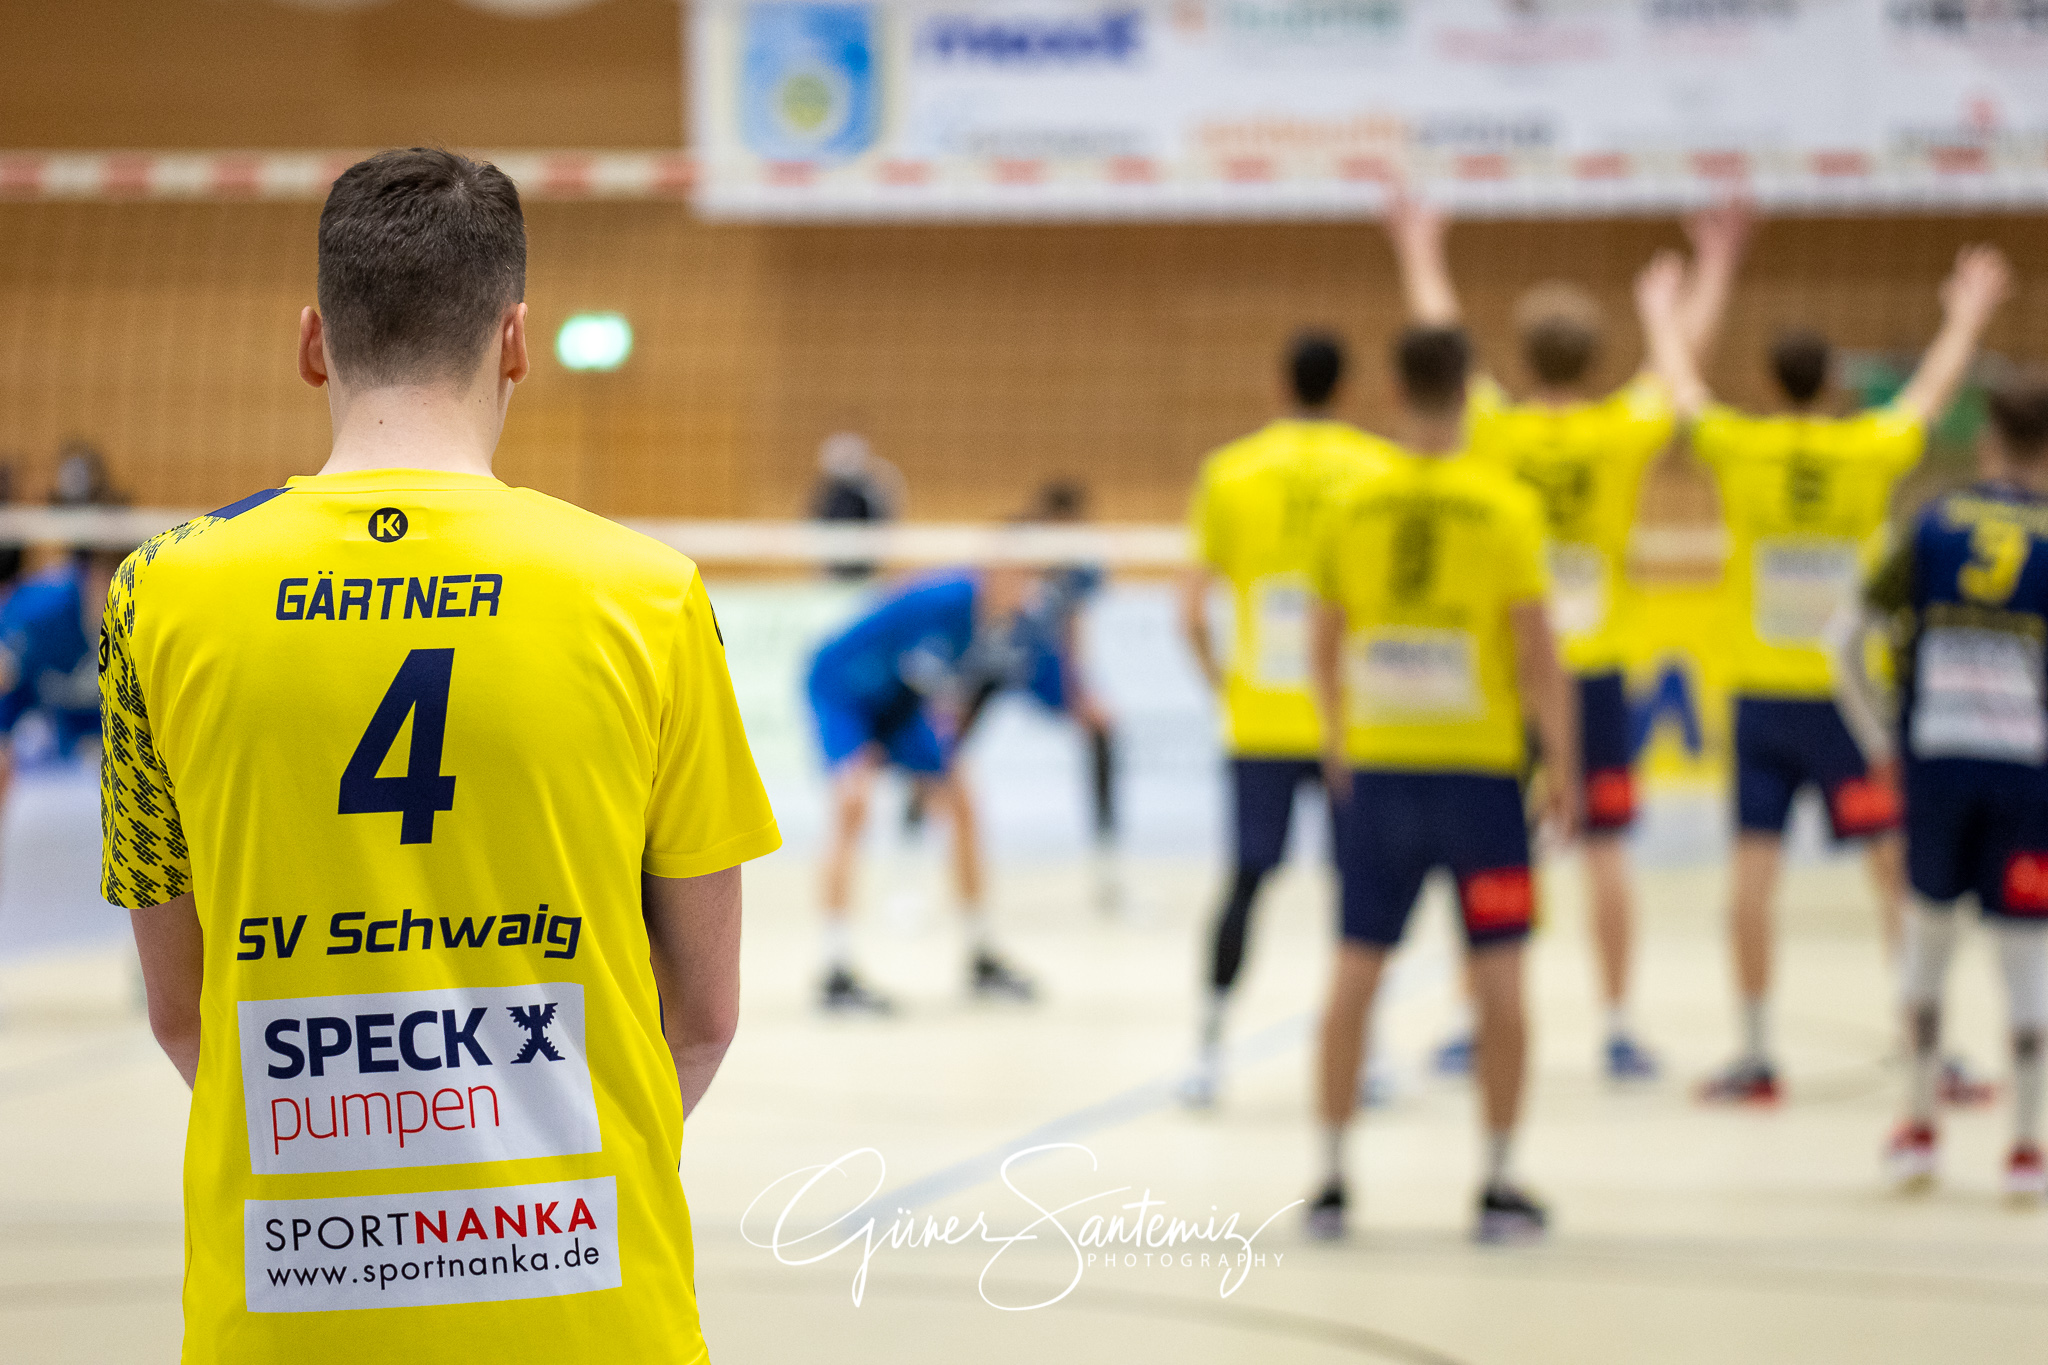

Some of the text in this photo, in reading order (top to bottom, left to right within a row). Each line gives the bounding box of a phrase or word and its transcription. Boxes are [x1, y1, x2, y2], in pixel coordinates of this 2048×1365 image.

[276, 569, 503, 621] GÄRTNER
[337, 647, 456, 845] 4
[236, 904, 582, 961] SV Schwaig
[264, 1007, 494, 1080] SPECK
[271, 1085, 500, 1155] pumpen
[265, 1198, 598, 1251] SPORTNANKA
[266, 1237, 600, 1290] www.sportnanka.de
